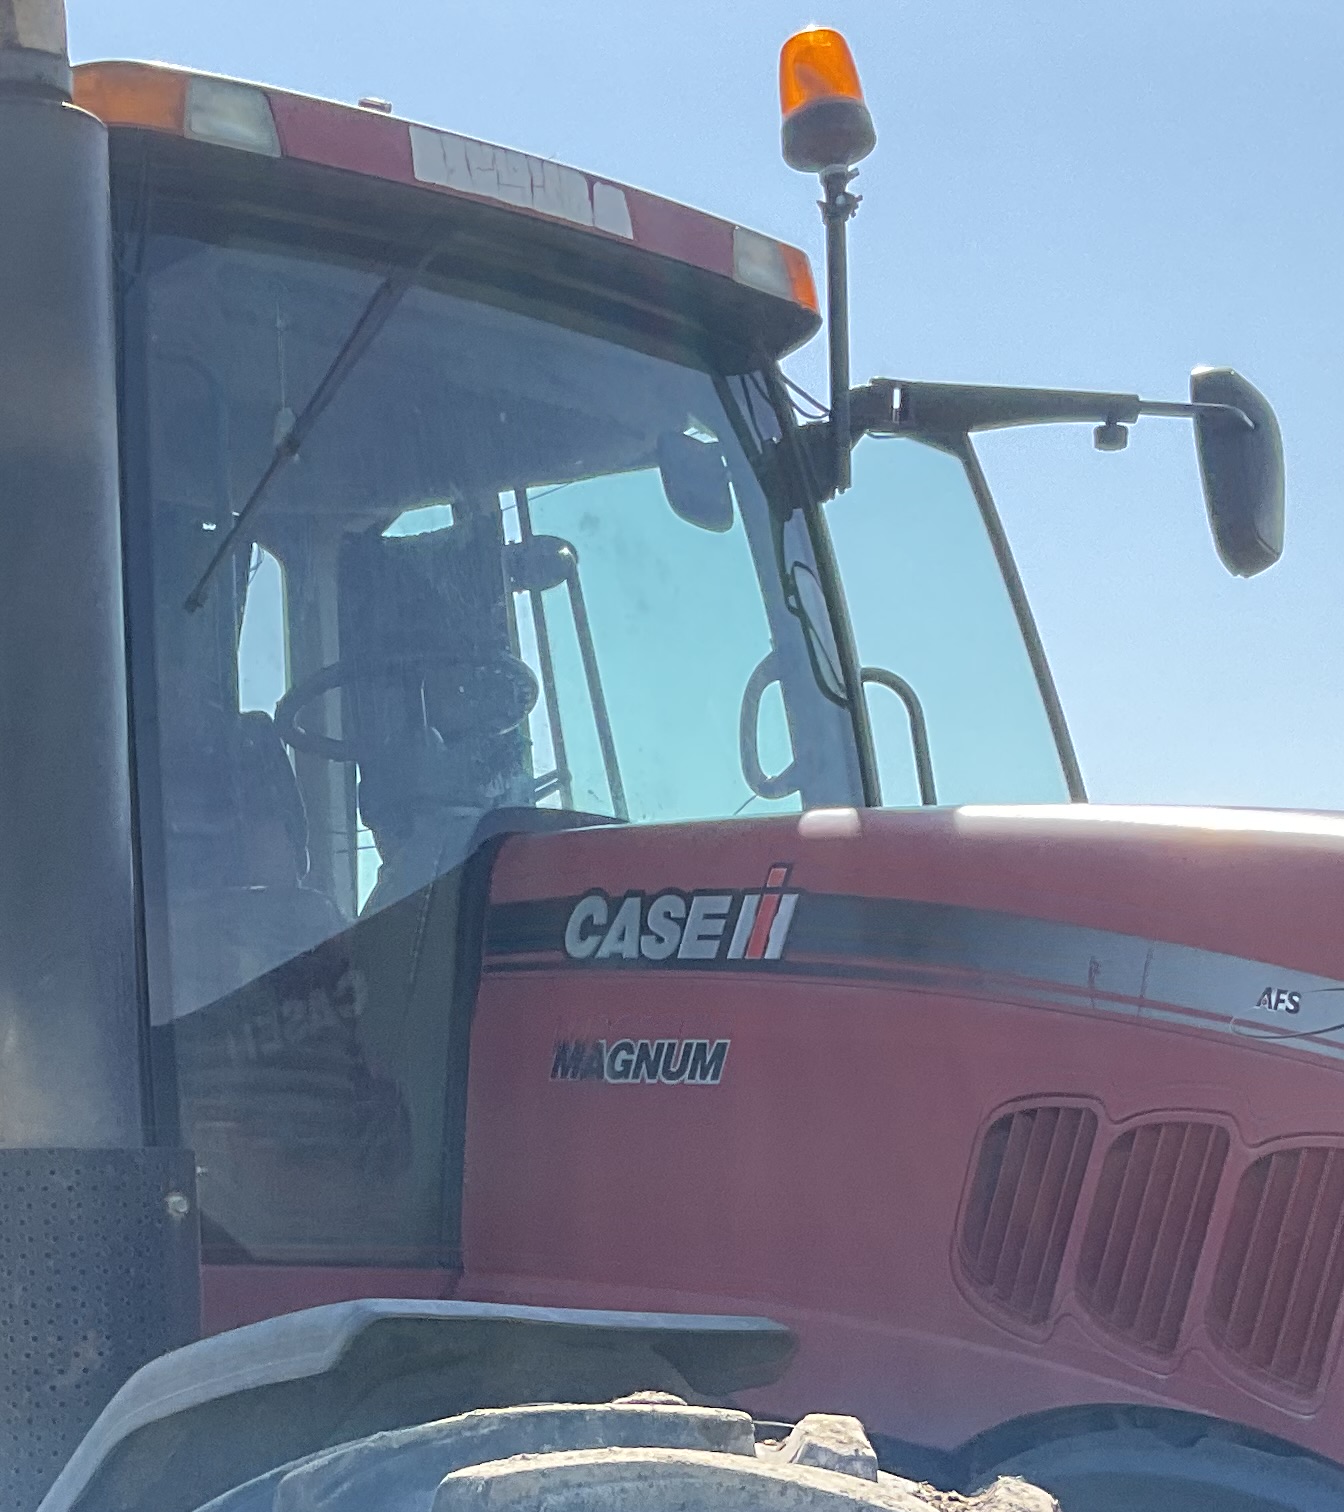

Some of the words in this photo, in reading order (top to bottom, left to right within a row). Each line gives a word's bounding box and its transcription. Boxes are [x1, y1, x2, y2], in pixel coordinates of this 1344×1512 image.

[563, 893, 733, 961] CASE
[1256, 986, 1301, 1014] AFS
[549, 1036, 732, 1086] MAGNUM
